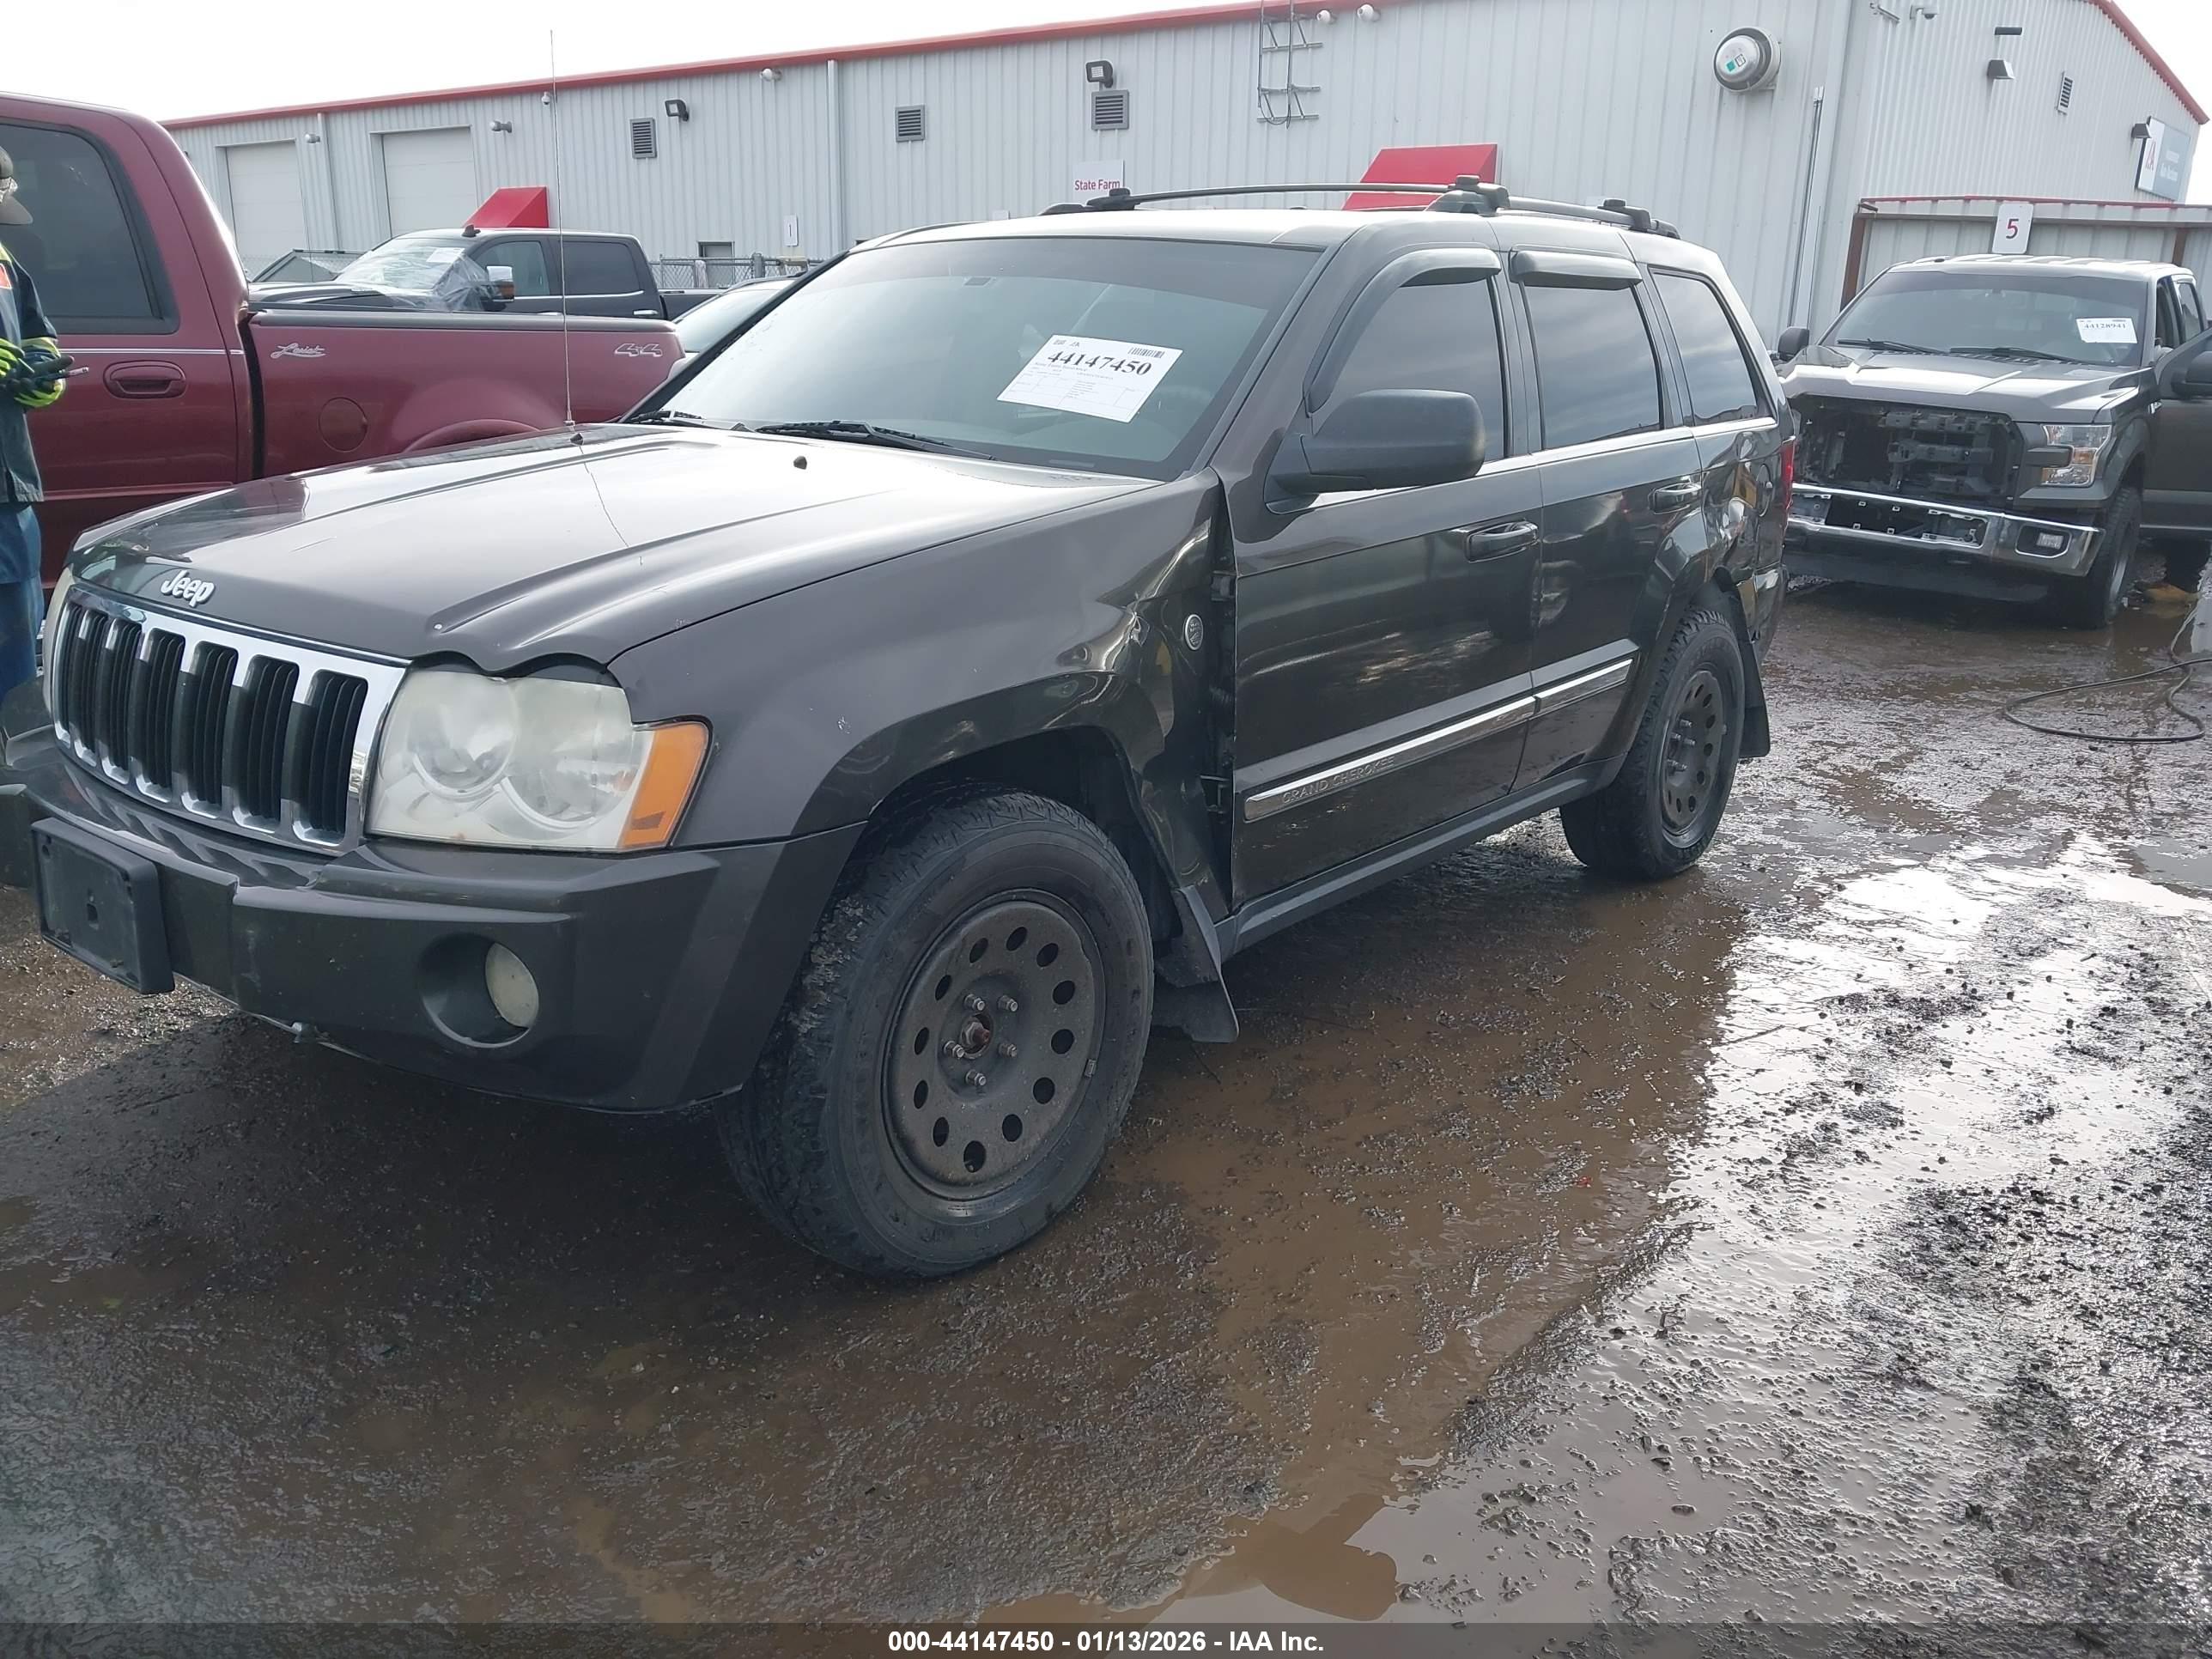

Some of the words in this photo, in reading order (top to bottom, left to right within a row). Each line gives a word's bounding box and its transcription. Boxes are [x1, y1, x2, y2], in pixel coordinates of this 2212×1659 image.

[1074, 180, 1096, 191] State
[1098, 179, 1121, 190] Farm
[2006, 218, 2020, 239] 5
[1048, 350, 1152, 375] 44147450
[161, 570, 216, 608] Jeep
[1283, 779, 1329, 804] GRAND
[1333, 756, 1395, 786] CHEROKEE
